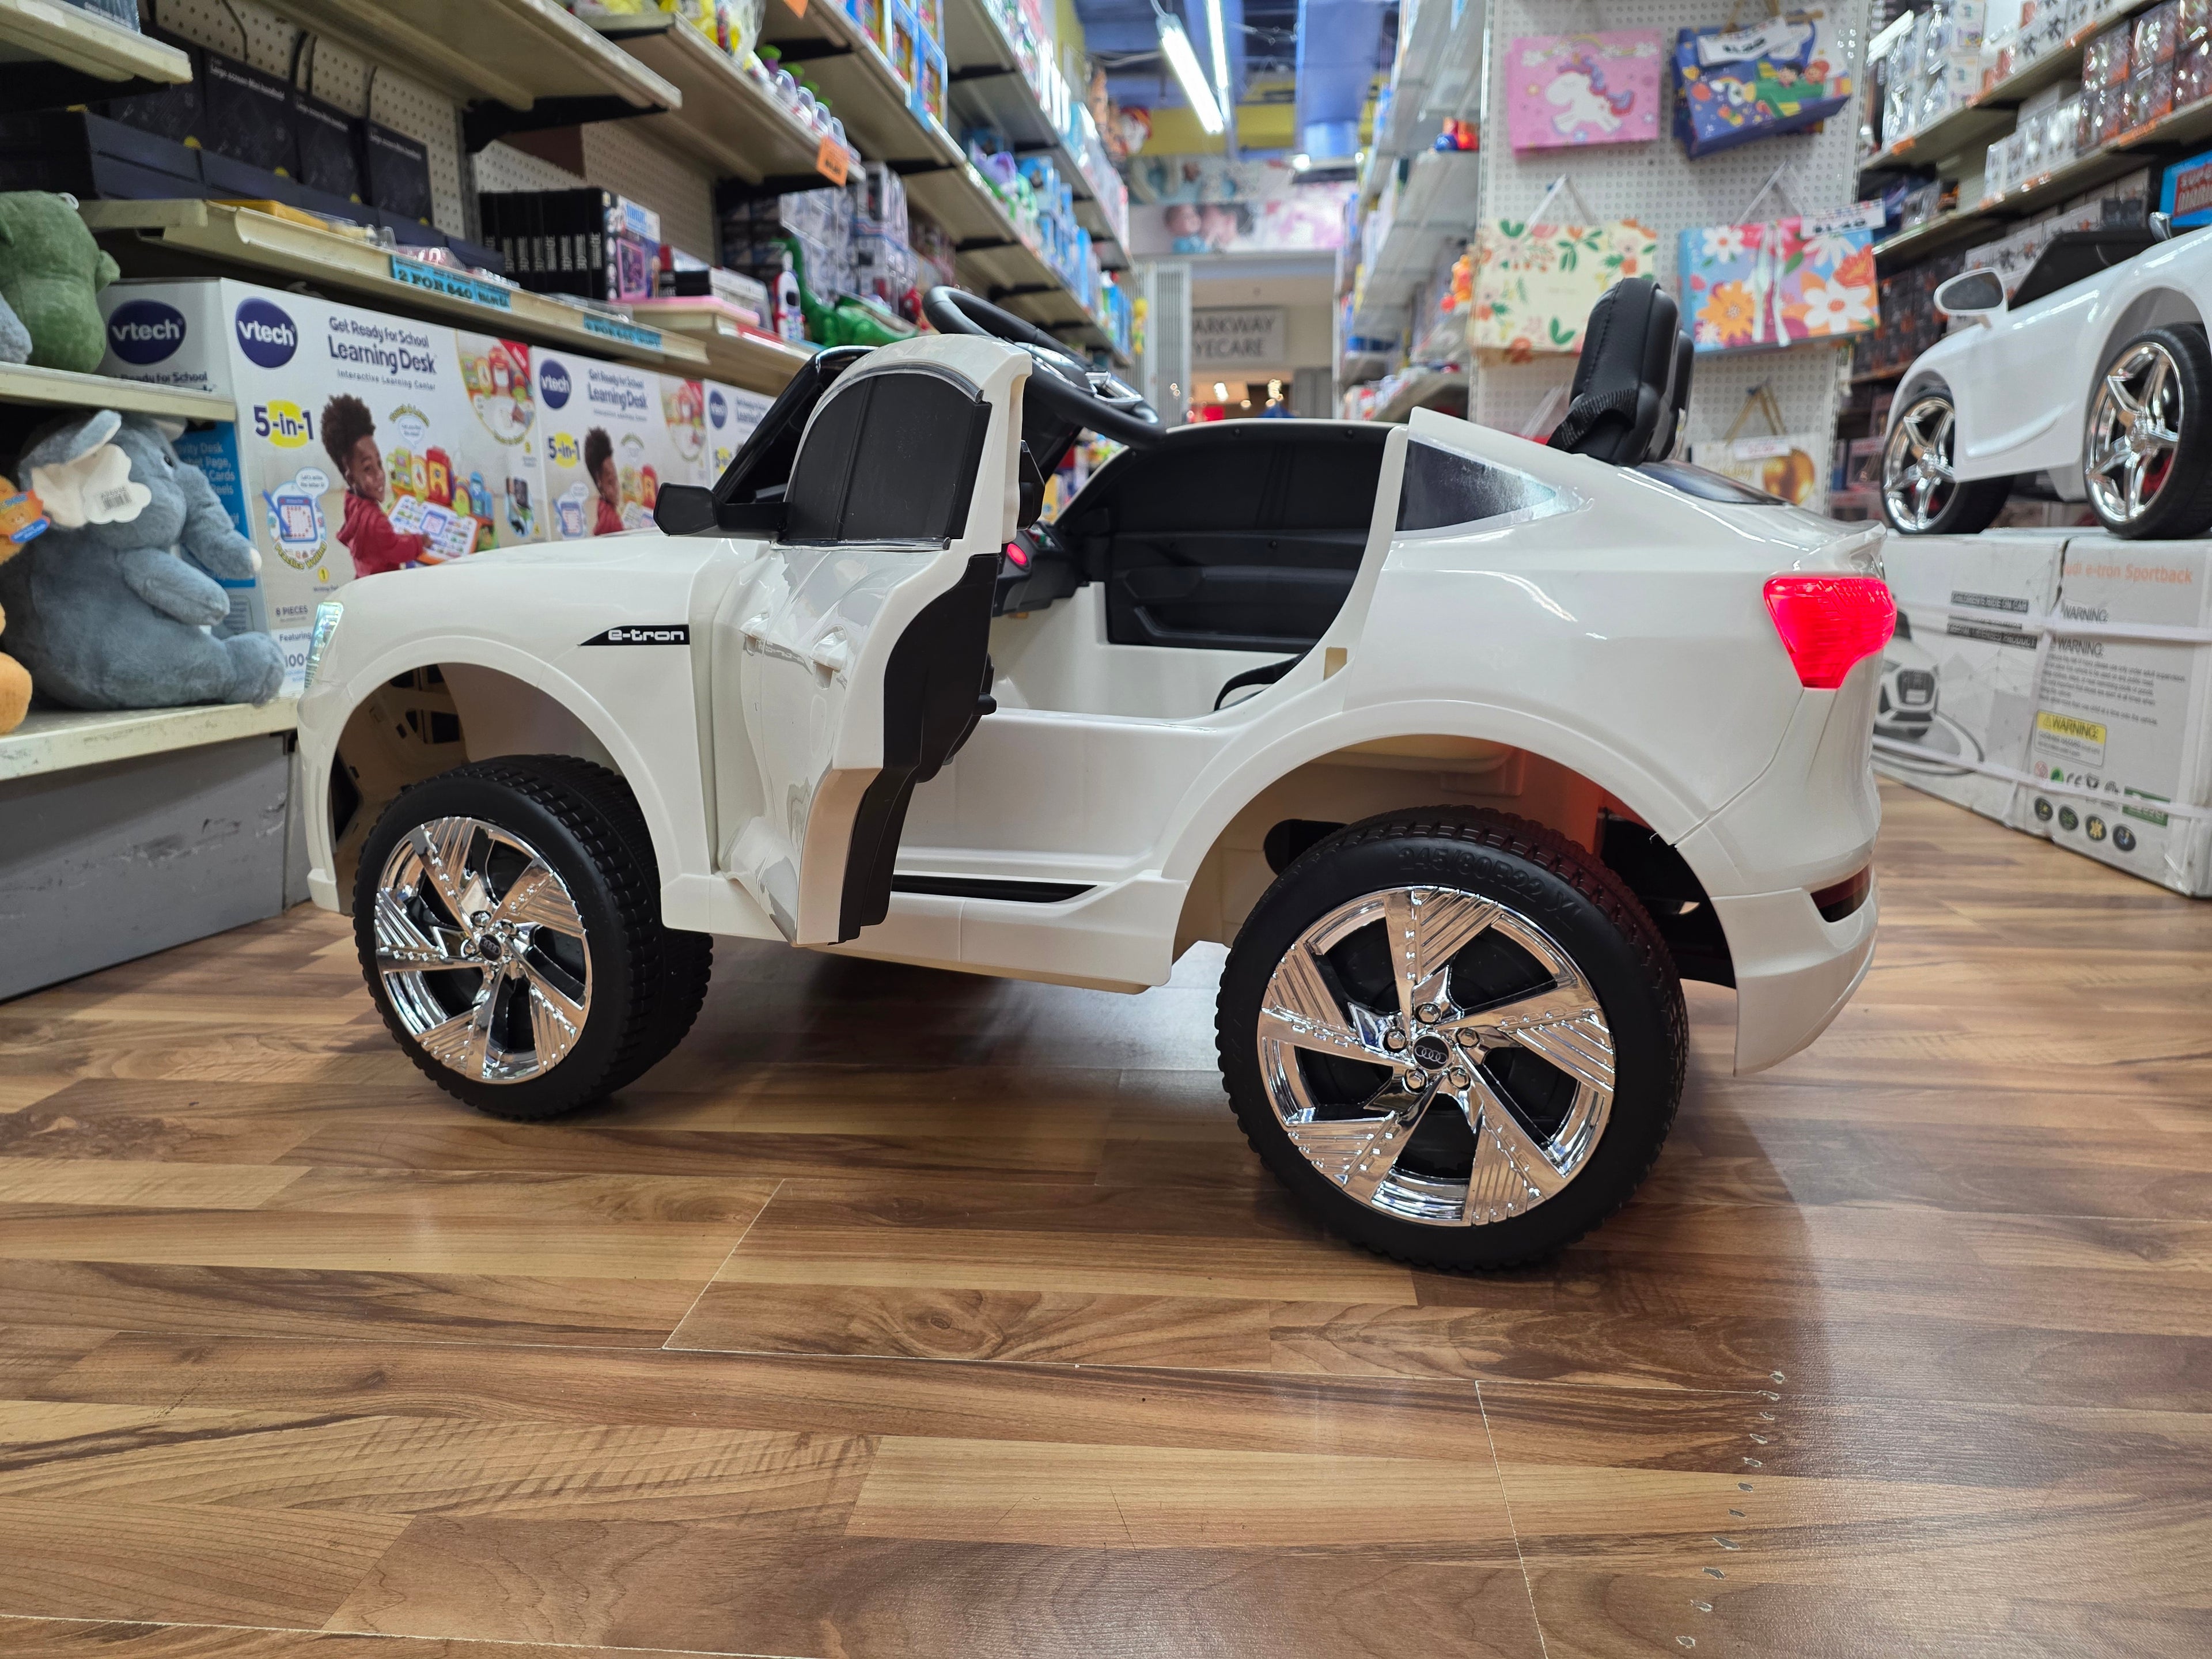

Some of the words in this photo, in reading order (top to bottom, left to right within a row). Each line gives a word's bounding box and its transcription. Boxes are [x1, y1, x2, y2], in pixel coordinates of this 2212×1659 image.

[112, 319, 180, 341] vtech
[237, 319, 294, 347] vtech
[329, 316, 350, 334] Get
[350, 320, 384, 344] Ready
[385, 326, 397, 341] for
[399, 329, 430, 349] School
[1192, 315, 1275, 333] ARKWAY
[328, 334, 399, 375] Learning
[399, 347, 437, 374] Desk
[1192, 338, 1264, 358] YECARE
[173, 372, 208, 383] School
[540, 374, 570, 394] vtech
[588, 381, 627, 411] Learning
[253, 404, 314, 440] 5-in-1
[2063, 562, 2082, 575] udi
[2085, 563, 2122, 577] e-tron
[2124, 562, 2192, 585] Sportback
[283, 605, 309, 616] PIECES
[279, 631, 312, 642] Featuring
[608, 628, 684, 641] e-tron
